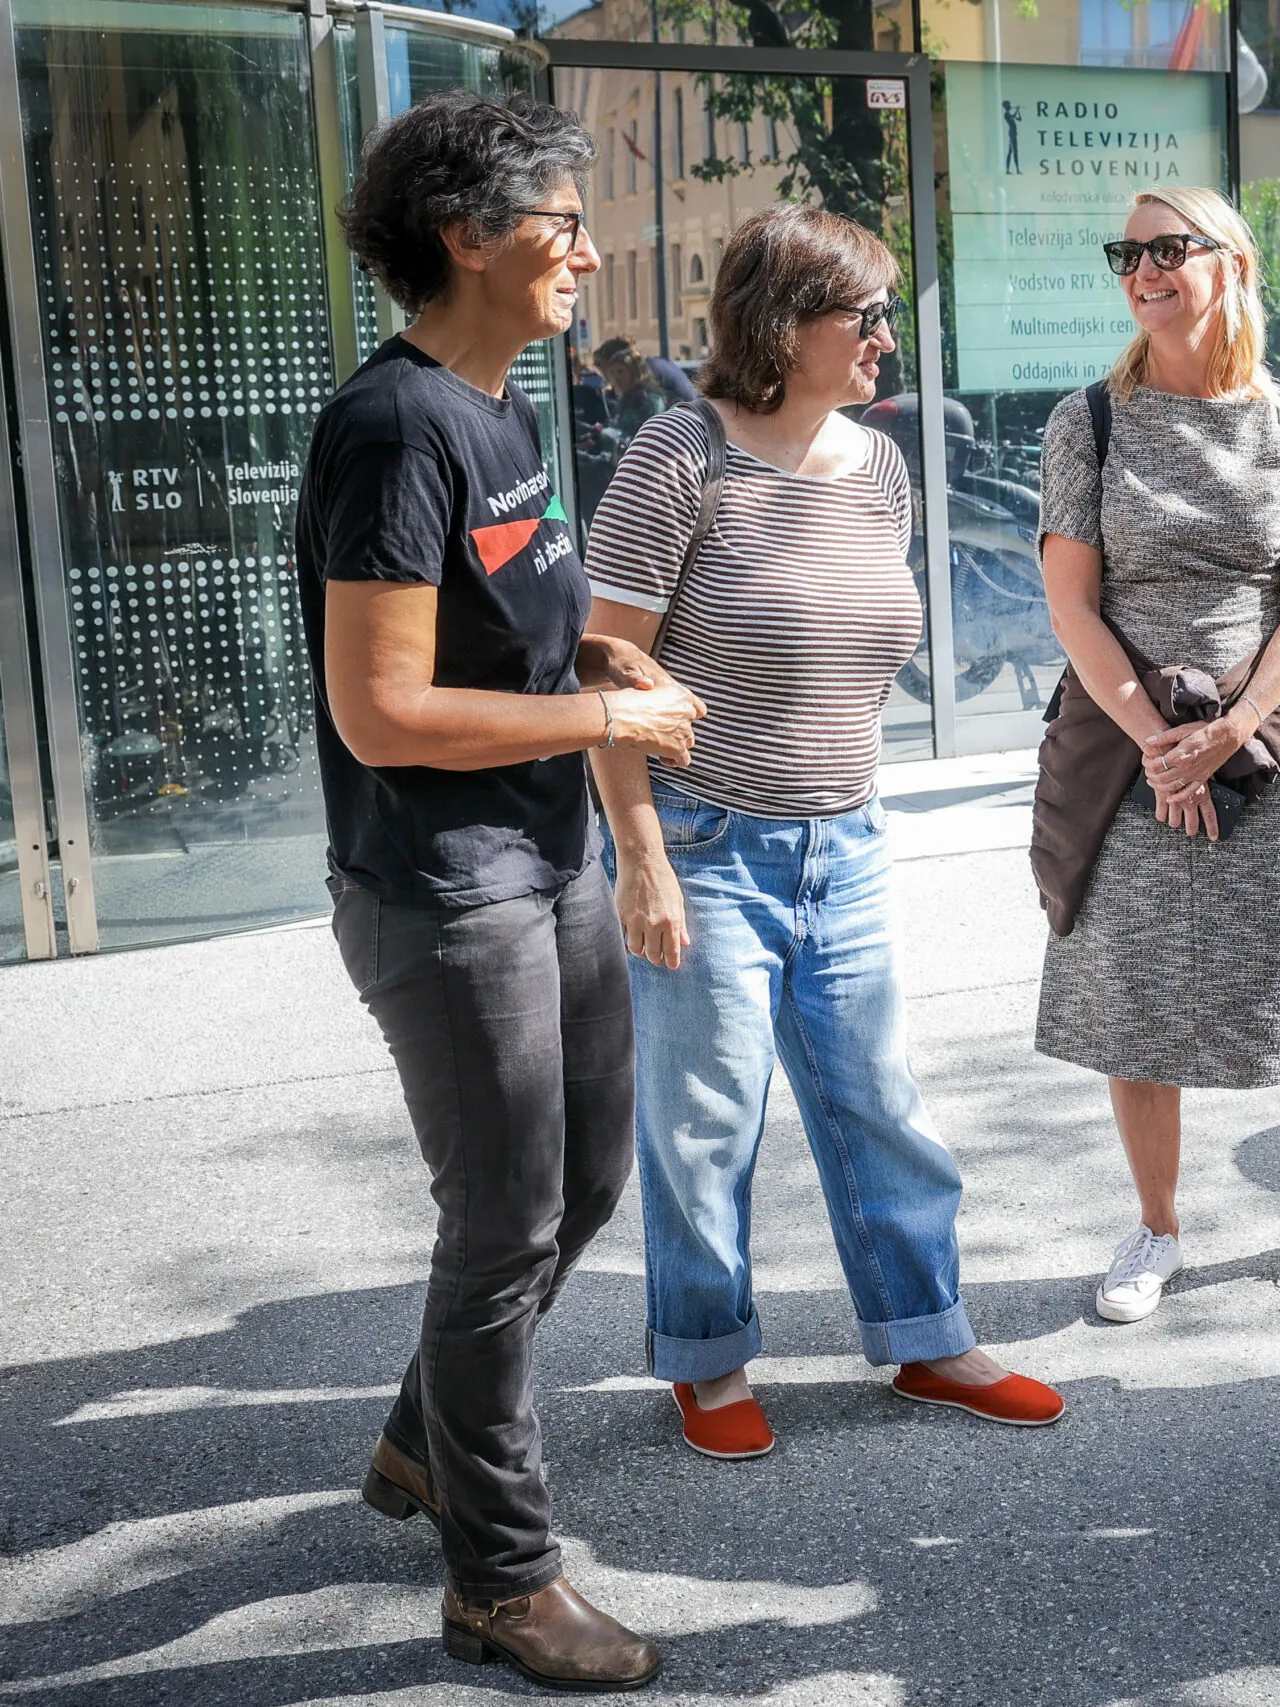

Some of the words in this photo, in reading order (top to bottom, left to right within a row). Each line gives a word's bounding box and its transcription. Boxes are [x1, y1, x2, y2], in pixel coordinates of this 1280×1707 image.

[1036, 100, 1119, 119] RADIO
[1037, 130, 1179, 153] TELEVIZIJA
[1039, 159, 1180, 181] SLOVENIJA
[1007, 226, 1073, 250] Televizija
[1078, 227, 1124, 246] Sloven
[1009, 272, 1066, 291] Vodstvo
[1071, 273, 1095, 290] RTV
[1010, 316, 1105, 339] Multimedijski
[1109, 318, 1137, 334] cen
[1012, 361, 1078, 383] Oddajniki
[1083, 361, 1096, 378] in
[132, 467, 179, 486] RTV
[225, 460, 300, 481] Televizija
[135, 492, 182, 511] SLO
[228, 484, 299, 506] Slovenija
[533, 548, 548, 576] ni
